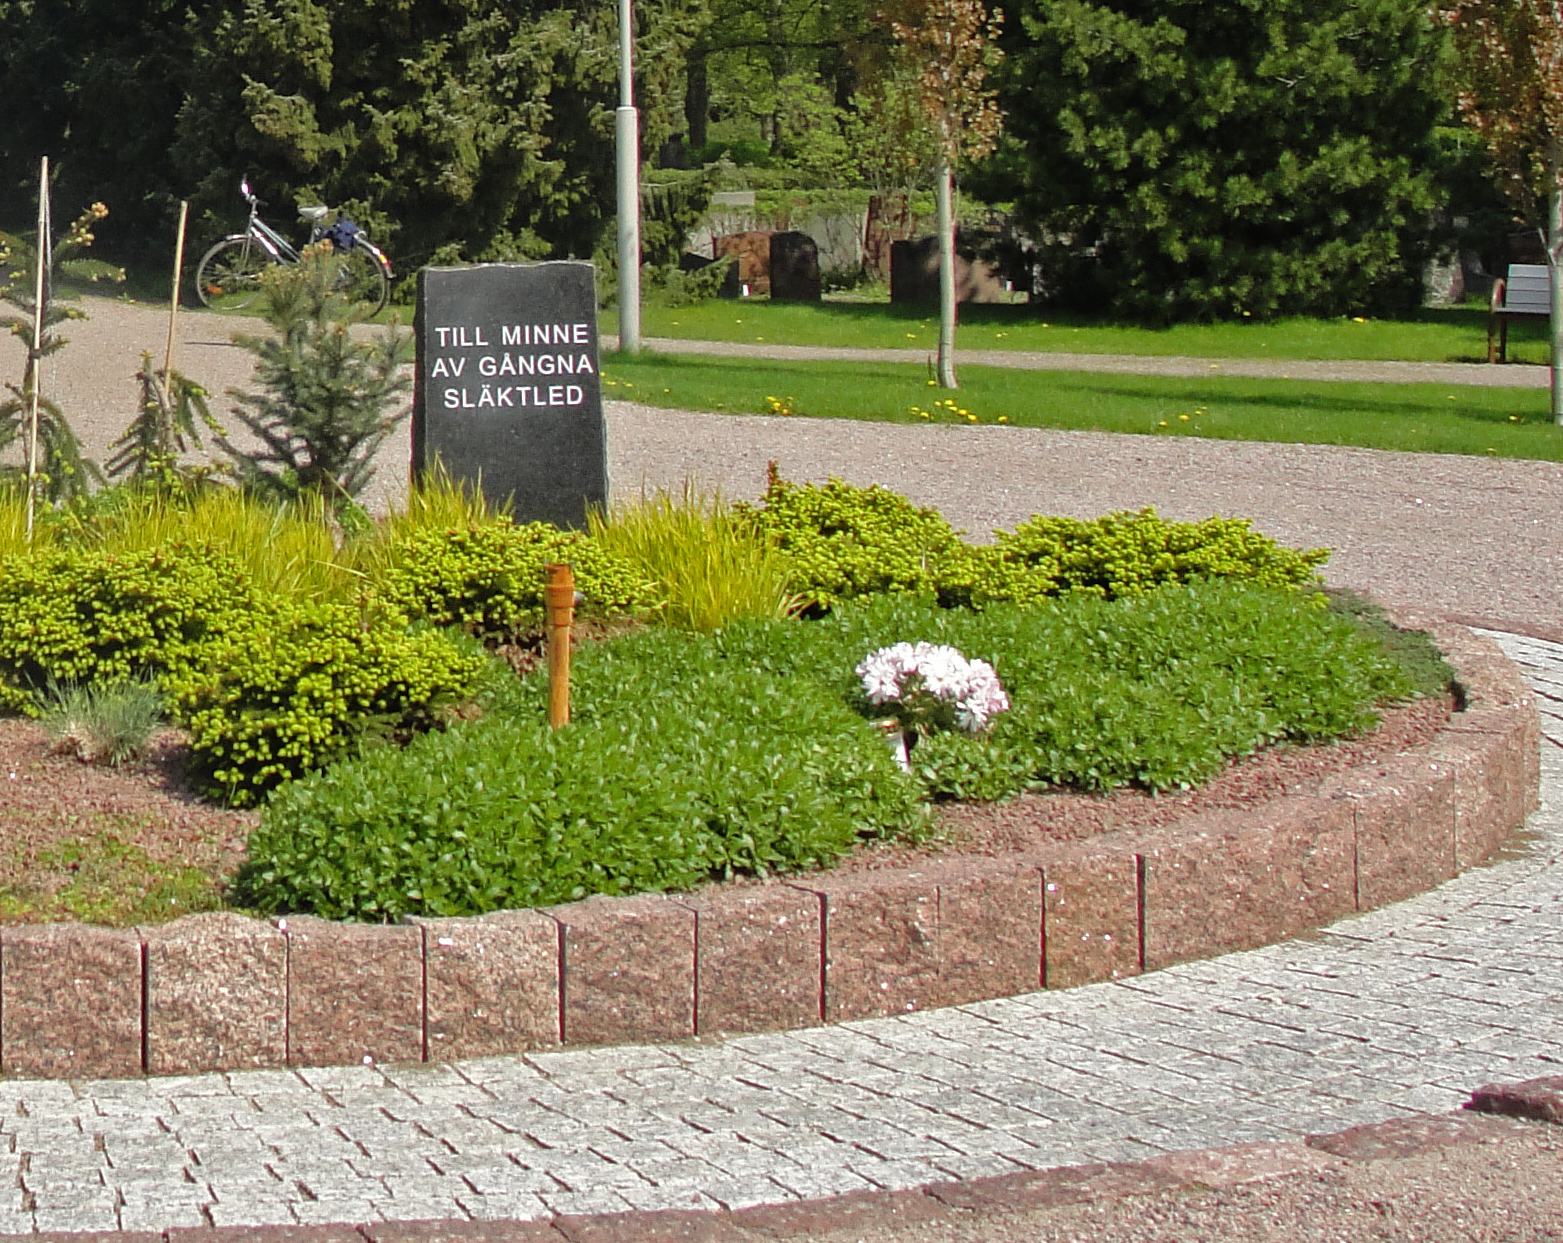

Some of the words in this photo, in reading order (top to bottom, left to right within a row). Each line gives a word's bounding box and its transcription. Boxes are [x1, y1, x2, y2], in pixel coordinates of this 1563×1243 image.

[434, 326, 489, 347] TILL
[502, 323, 589, 346] MINNE
[431, 357, 466, 378] AV
[478, 352, 594, 377] GÅNGNA
[444, 384, 583, 409] SLÄKTLED
